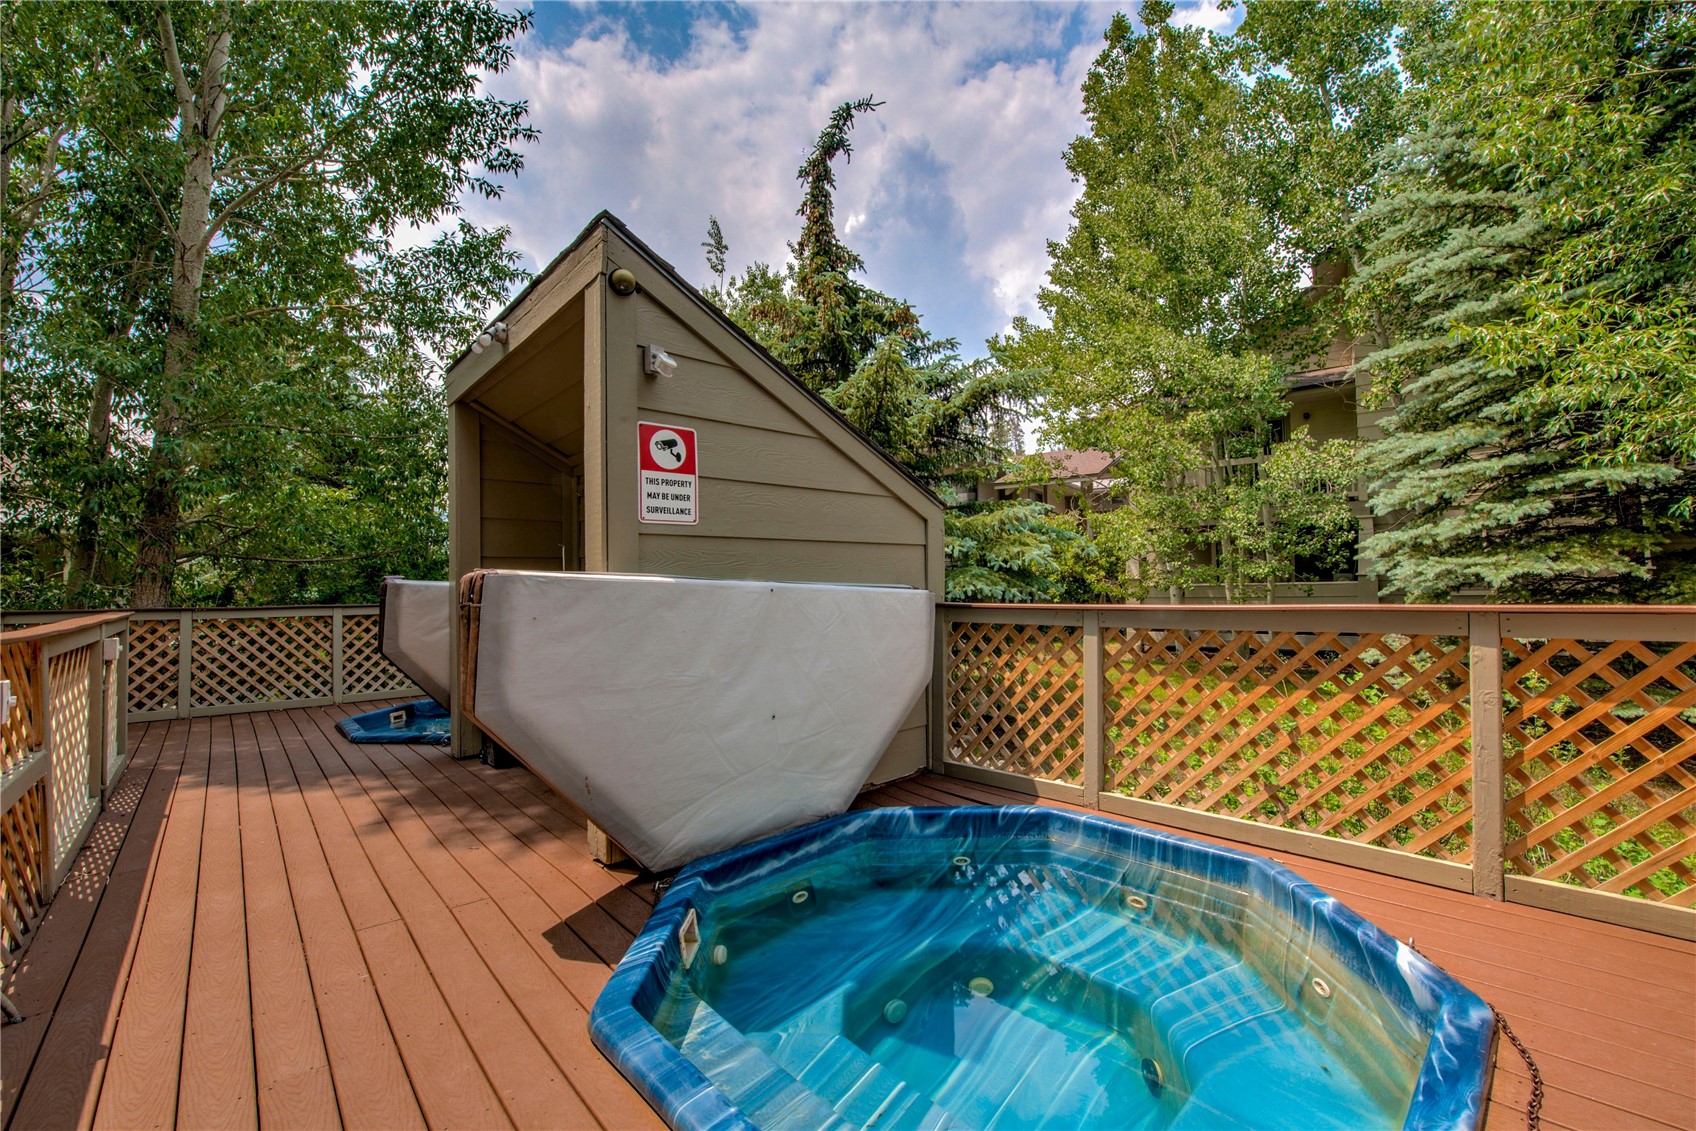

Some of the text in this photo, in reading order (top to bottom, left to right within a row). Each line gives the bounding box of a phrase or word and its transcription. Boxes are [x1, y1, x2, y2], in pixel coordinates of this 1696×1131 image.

[645, 477, 692, 488] THIS PROPERTY
[647, 492, 691, 502] MAY BE UNDER
[646, 506, 691, 515] SURVEILLANCE
